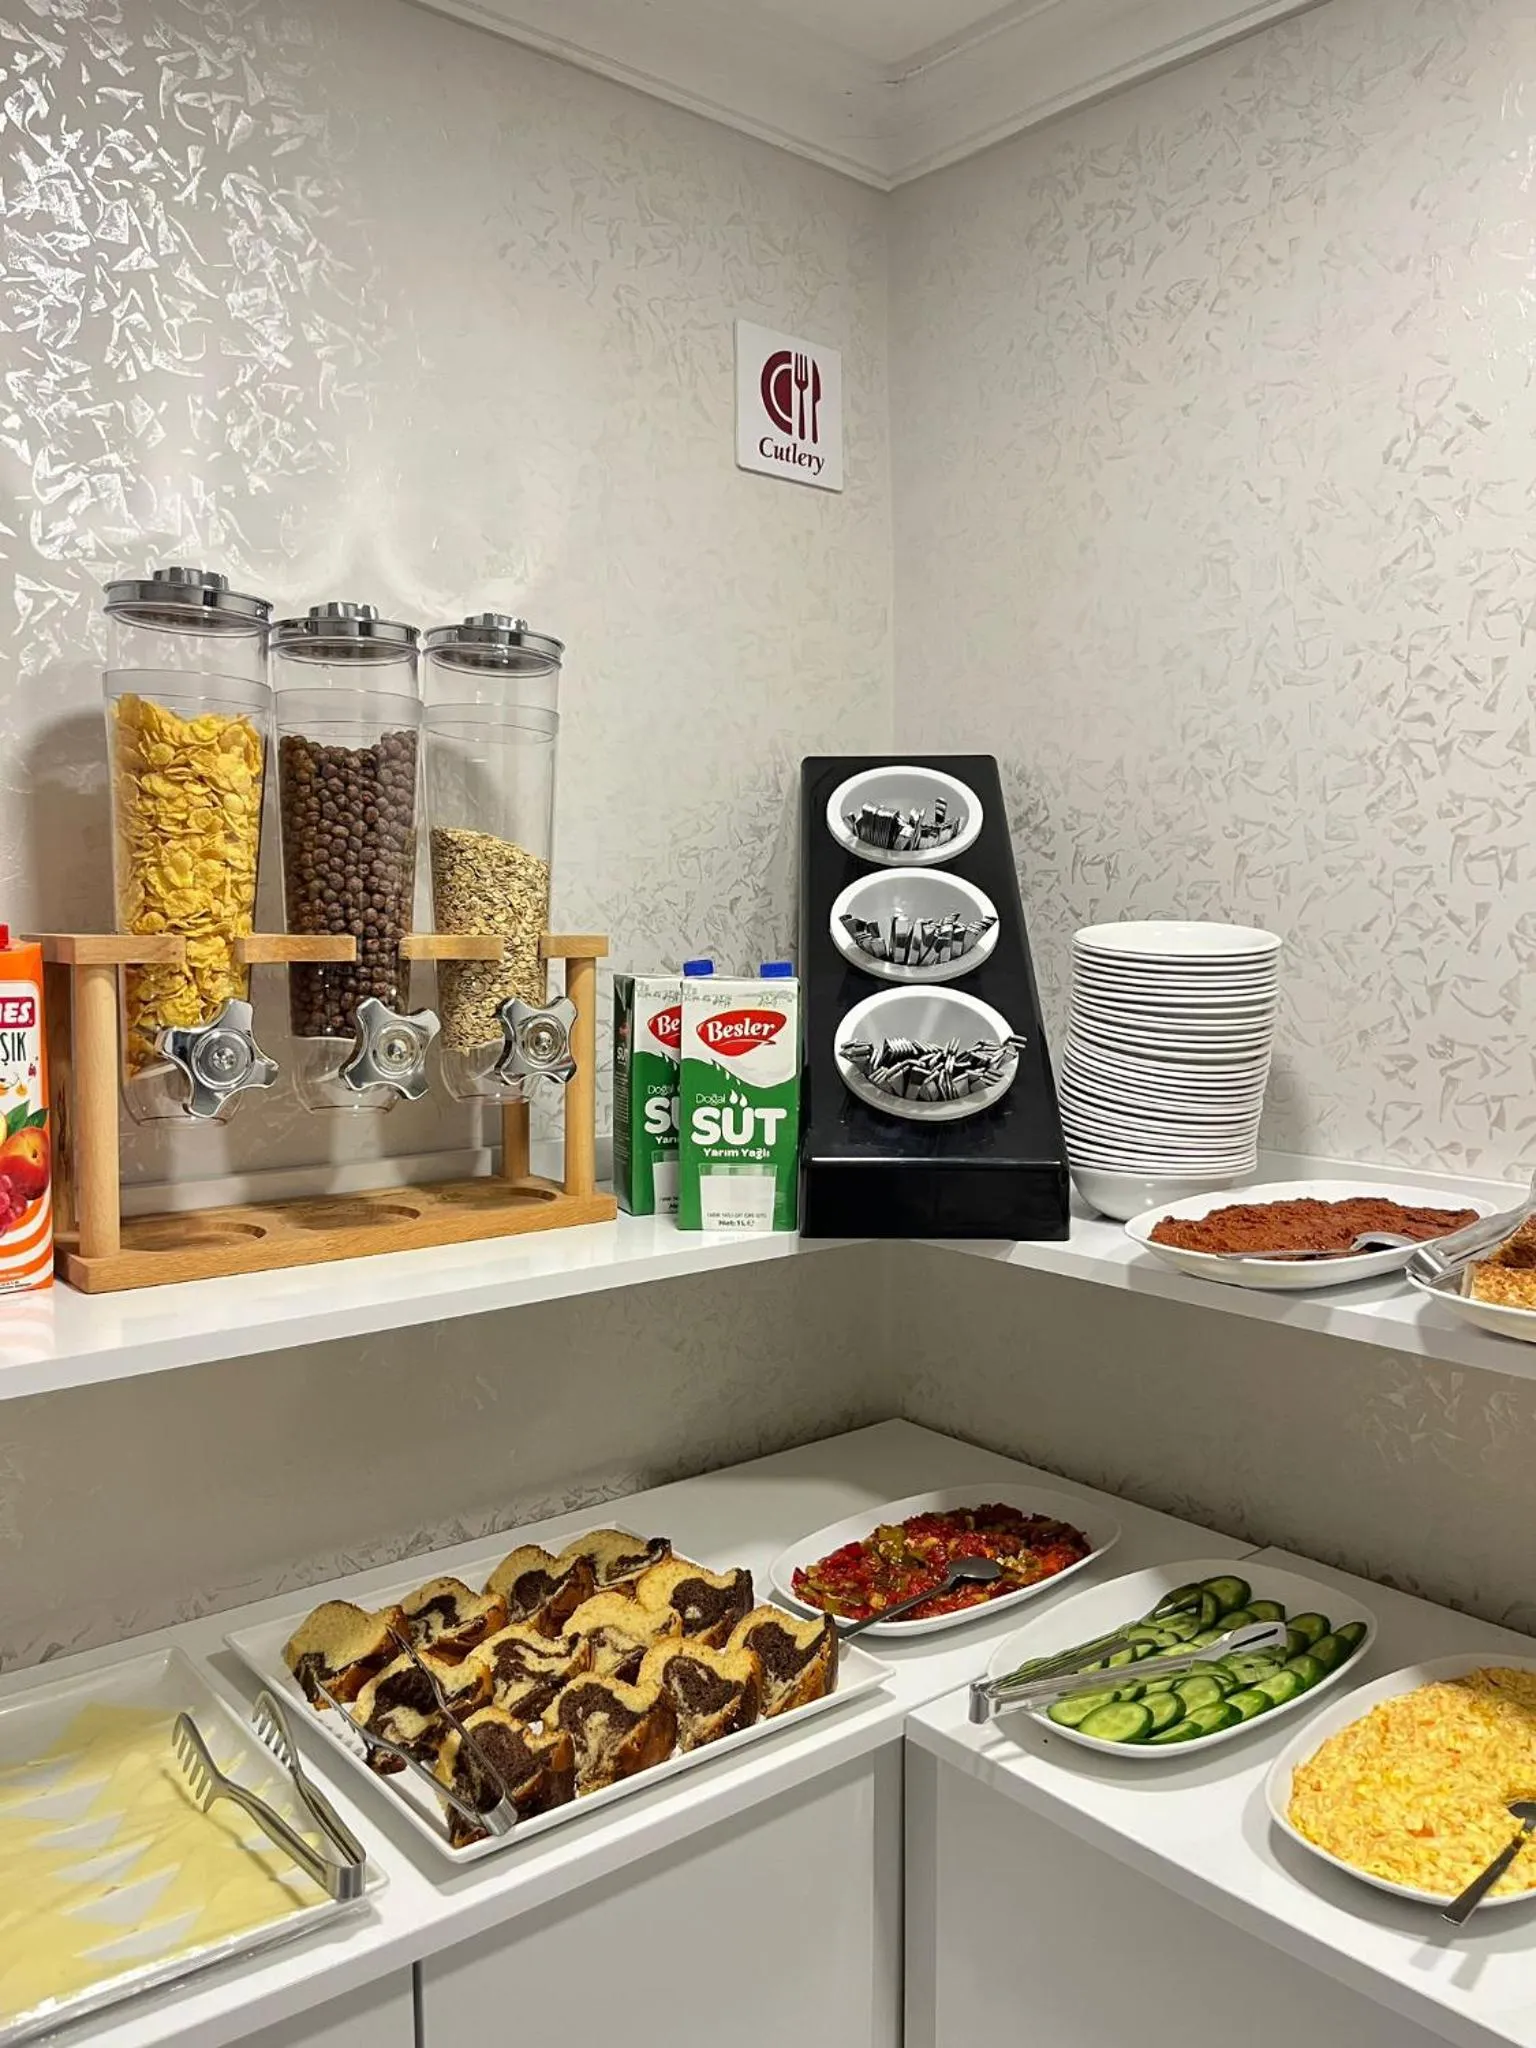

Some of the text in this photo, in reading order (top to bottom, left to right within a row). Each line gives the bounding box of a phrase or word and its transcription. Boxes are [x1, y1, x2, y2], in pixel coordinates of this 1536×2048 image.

[758, 436, 825, 476] Cutlery
[0, 1001, 33, 1024] ES
[706, 1017, 775, 1043] Besler
[695, 1093, 726, 1106] Doğal
[690, 1098, 788, 1146] SÜT
[703, 1147, 771, 1160] Yarım Yağlı
